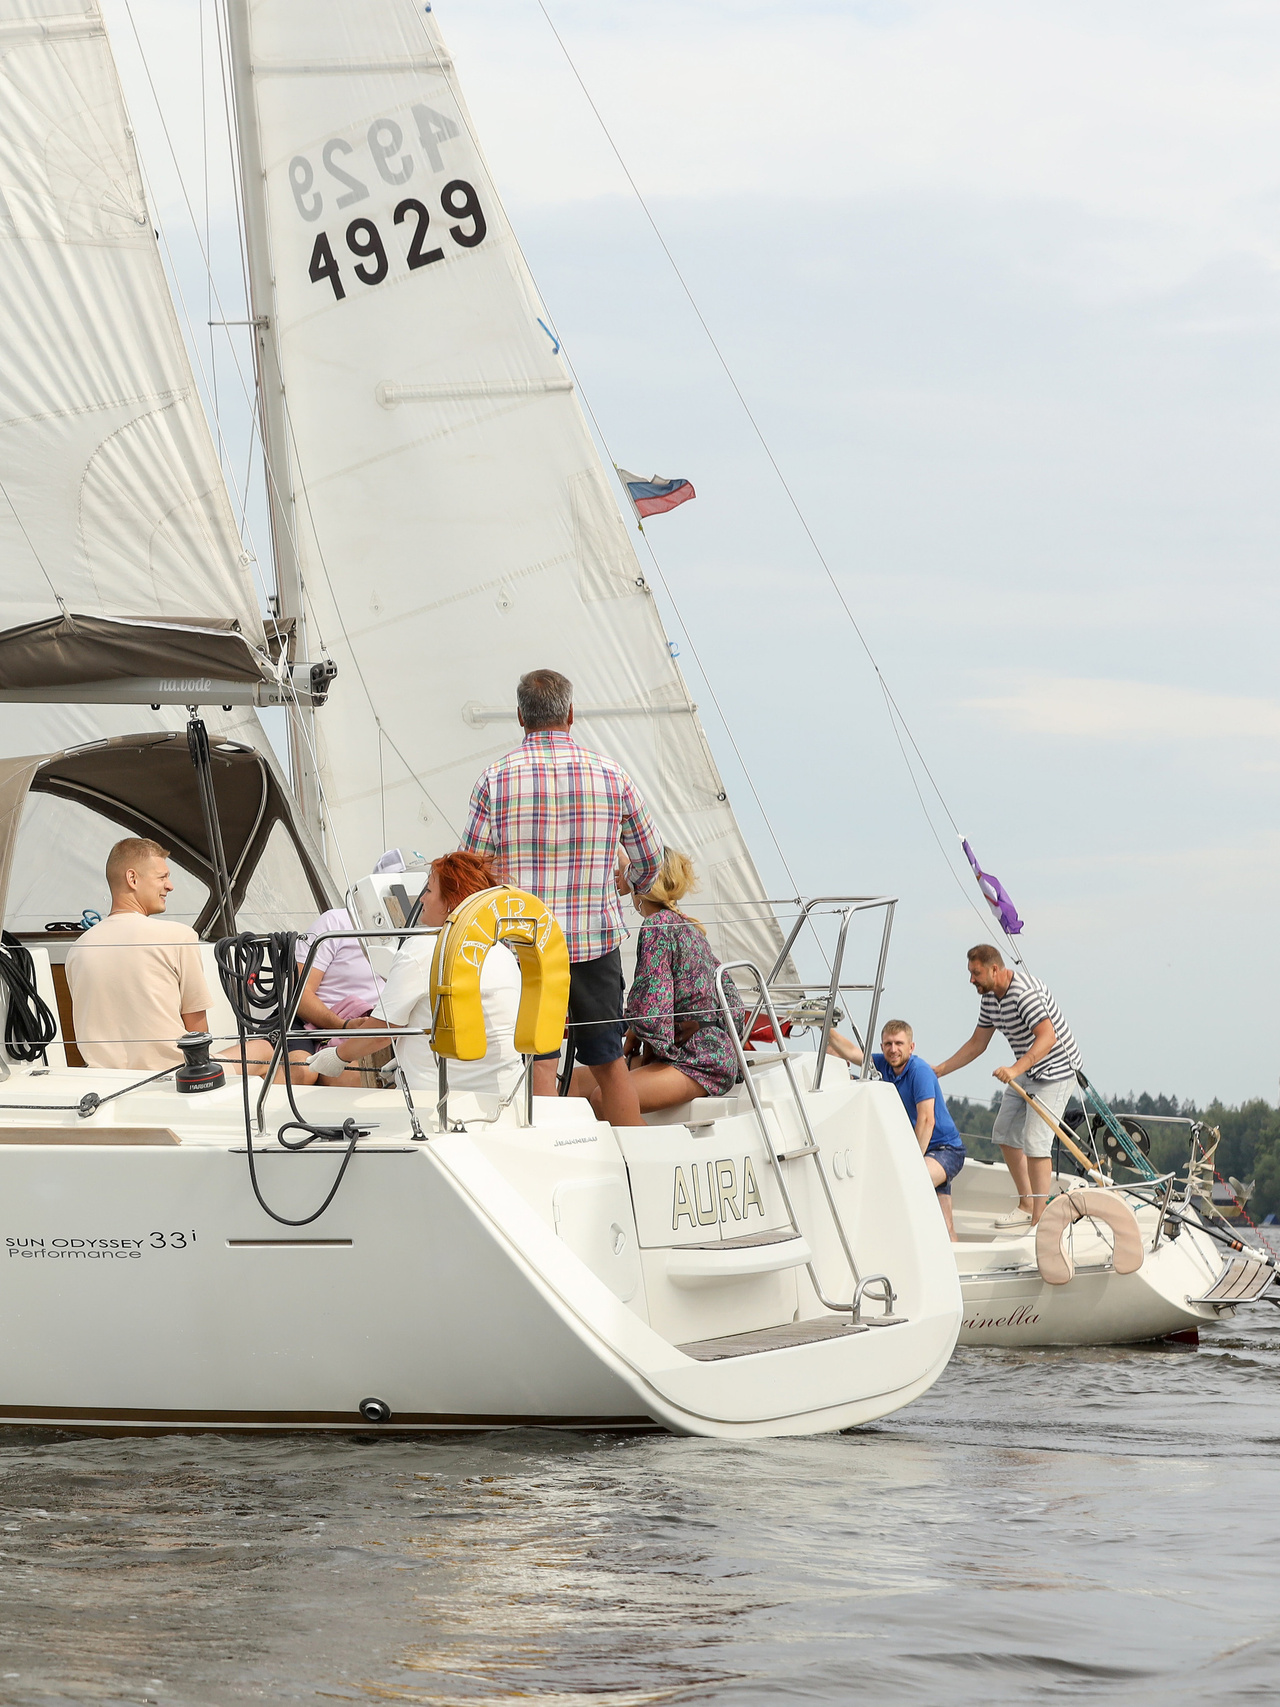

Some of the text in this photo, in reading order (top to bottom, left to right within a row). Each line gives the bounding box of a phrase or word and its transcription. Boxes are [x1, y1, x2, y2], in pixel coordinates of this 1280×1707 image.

[308, 179, 487, 301] 4929
[672, 1156, 765, 1231] AURA
[5, 1238, 45, 1248] SUN
[51, 1238, 144, 1249] ODYSSEY
[8, 1248, 142, 1259] Performance
[962, 1304, 1041, 1329] inella
